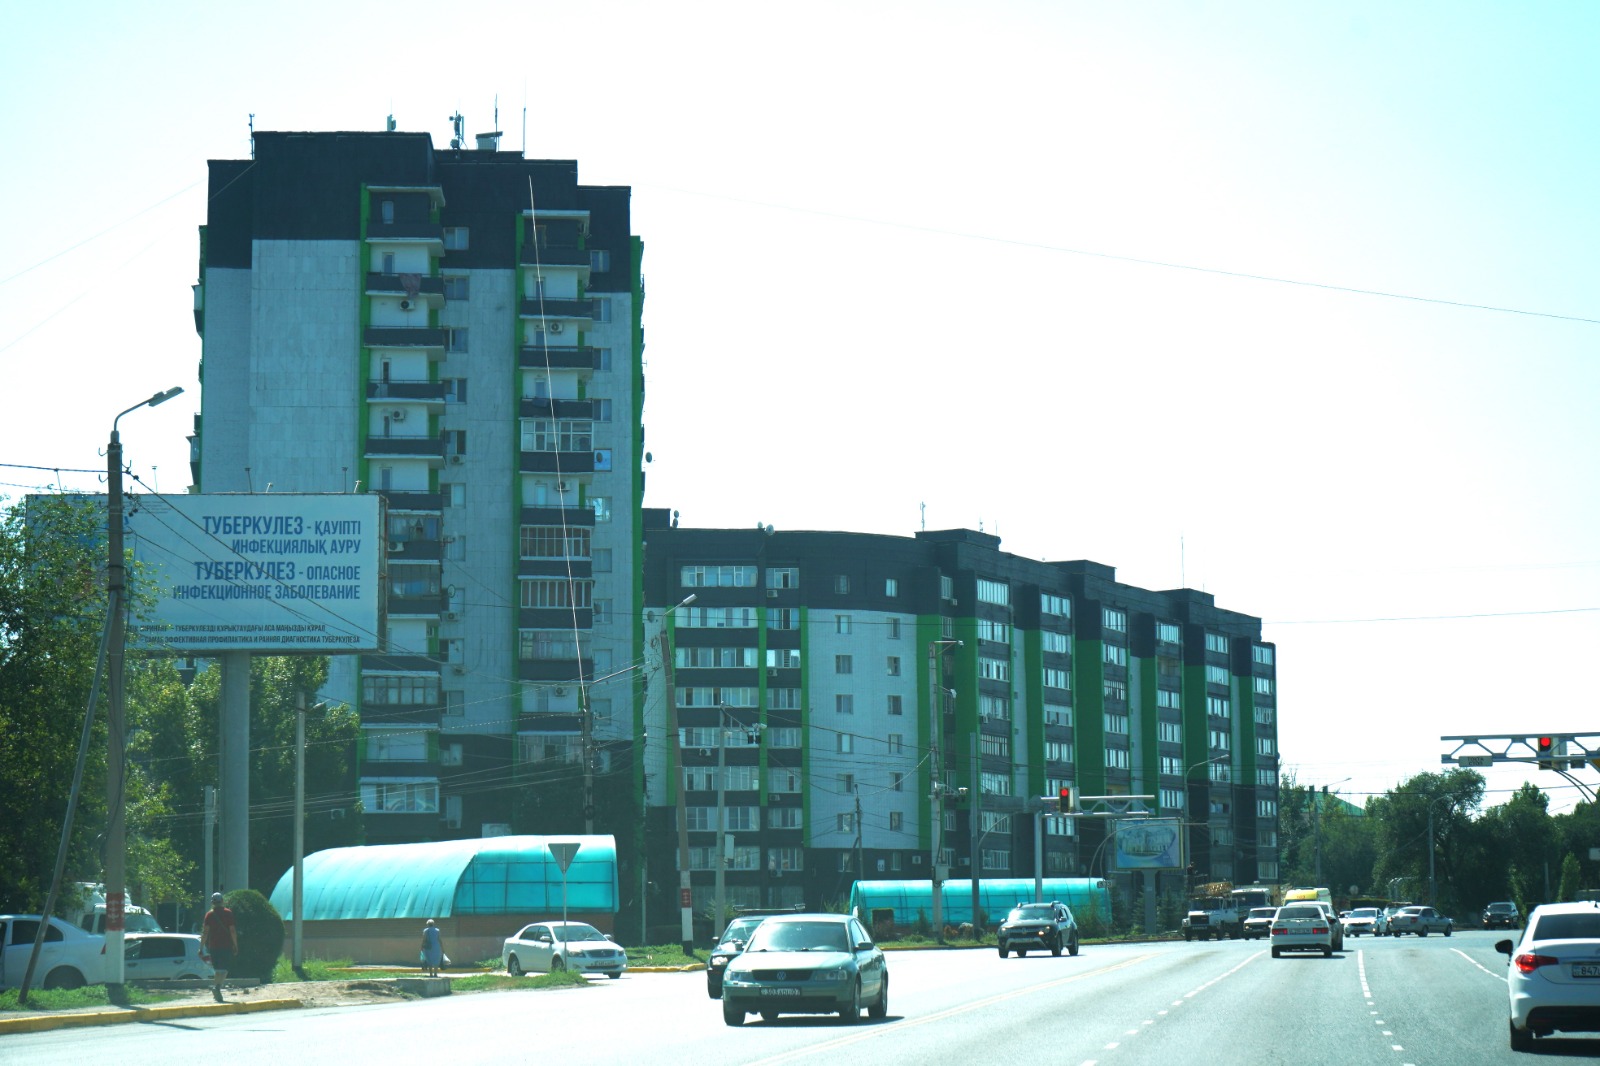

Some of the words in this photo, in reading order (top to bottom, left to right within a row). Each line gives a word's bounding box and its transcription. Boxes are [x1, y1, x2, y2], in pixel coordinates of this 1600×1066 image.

[203, 516, 303, 535] ТУБЕРКУЛЕЗ
[315, 521, 361, 536] ҚАУІПТІ
[232, 539, 327, 555] ИНФЕКЦИЯЛЫҚ
[330, 539, 361, 554] АУРУ
[194, 561, 296, 581] ТУБЕРКУЛЕЗ
[307, 566, 361, 580] ОПАСНОЕ
[173, 585, 272, 601] ИНФЕКЦИОННОЕ
[275, 584, 361, 600] ЗАБОЛЕВАНИЕ
[175, 624, 216, 632] ТУБЕРКУЛЕЗДІ
